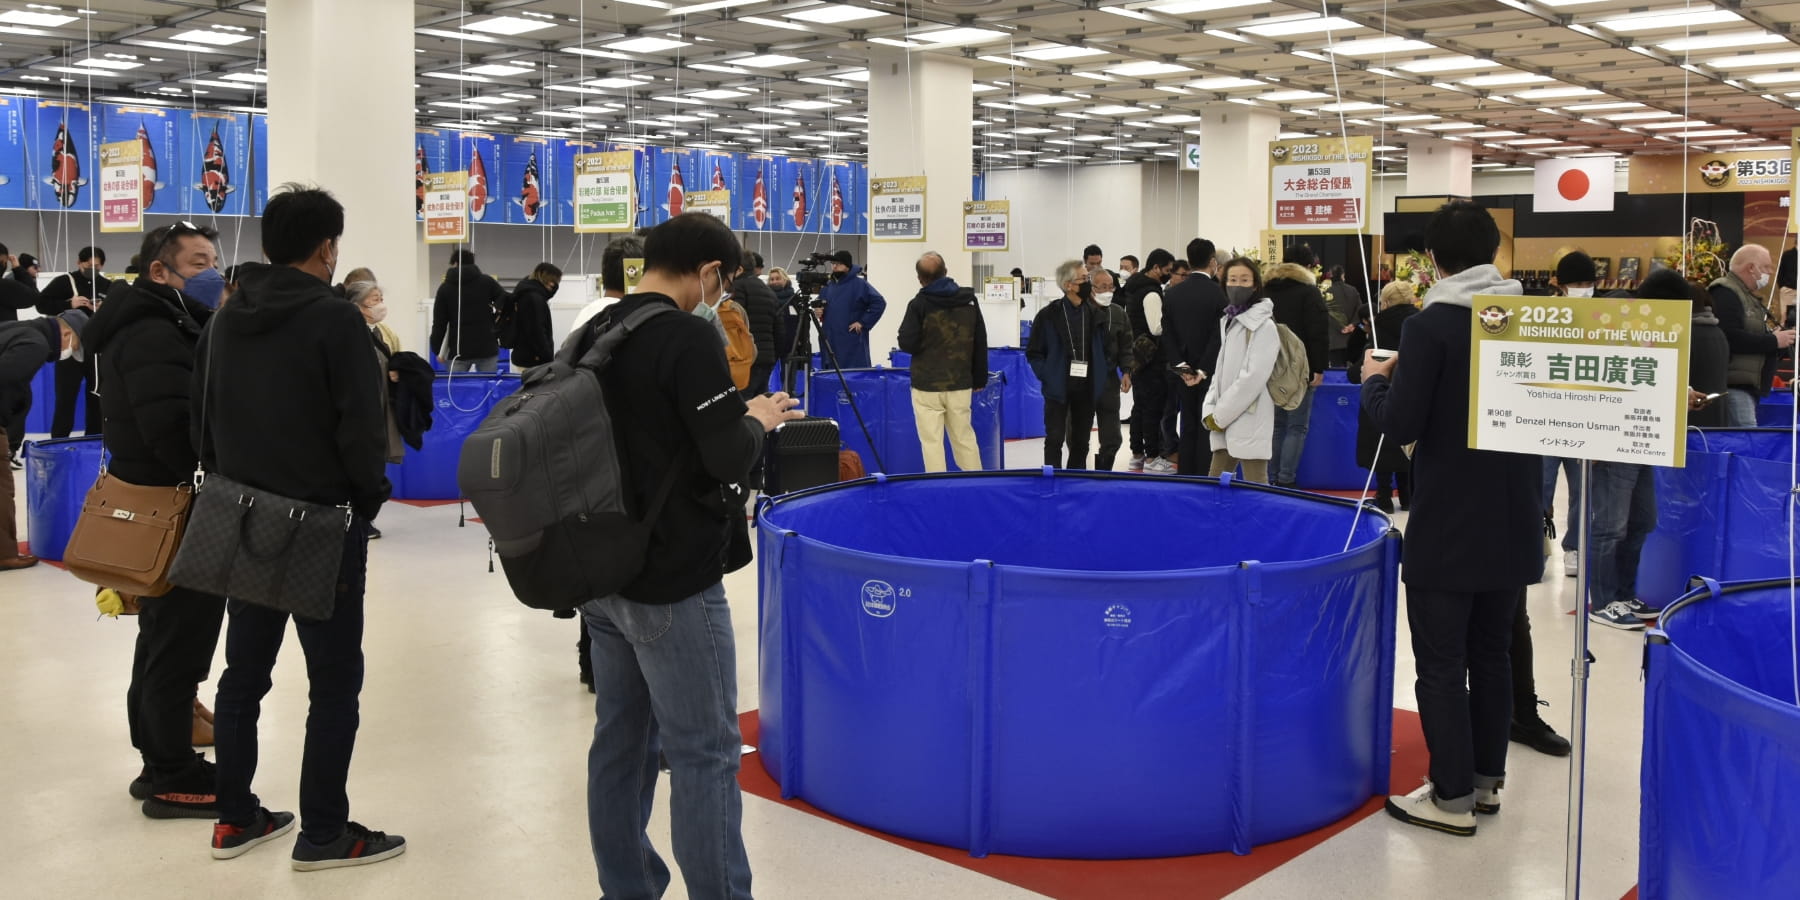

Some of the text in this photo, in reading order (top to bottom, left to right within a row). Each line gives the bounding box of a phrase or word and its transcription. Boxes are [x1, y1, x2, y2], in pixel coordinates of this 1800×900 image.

[1292, 144, 1319, 154] 2023
[1307, 168, 1331, 176] 第53回
[1737, 160, 1792, 177] 第53回
[1284, 177, 1352, 191] 大会総合優勝
[1519, 306, 1573, 324] 2023
[1519, 326, 1679, 343] NISHIKIGOI of THE WORLD
[1547, 353, 1658, 387] 吉田廣賞
[1526, 388, 1623, 404] Yoshida Hiroshi Prize
[1487, 408, 1513, 417] 第90部
[1515, 416, 1620, 432] Denzel Henson Usman
[1539, 437, 1586, 448] インドネシア
